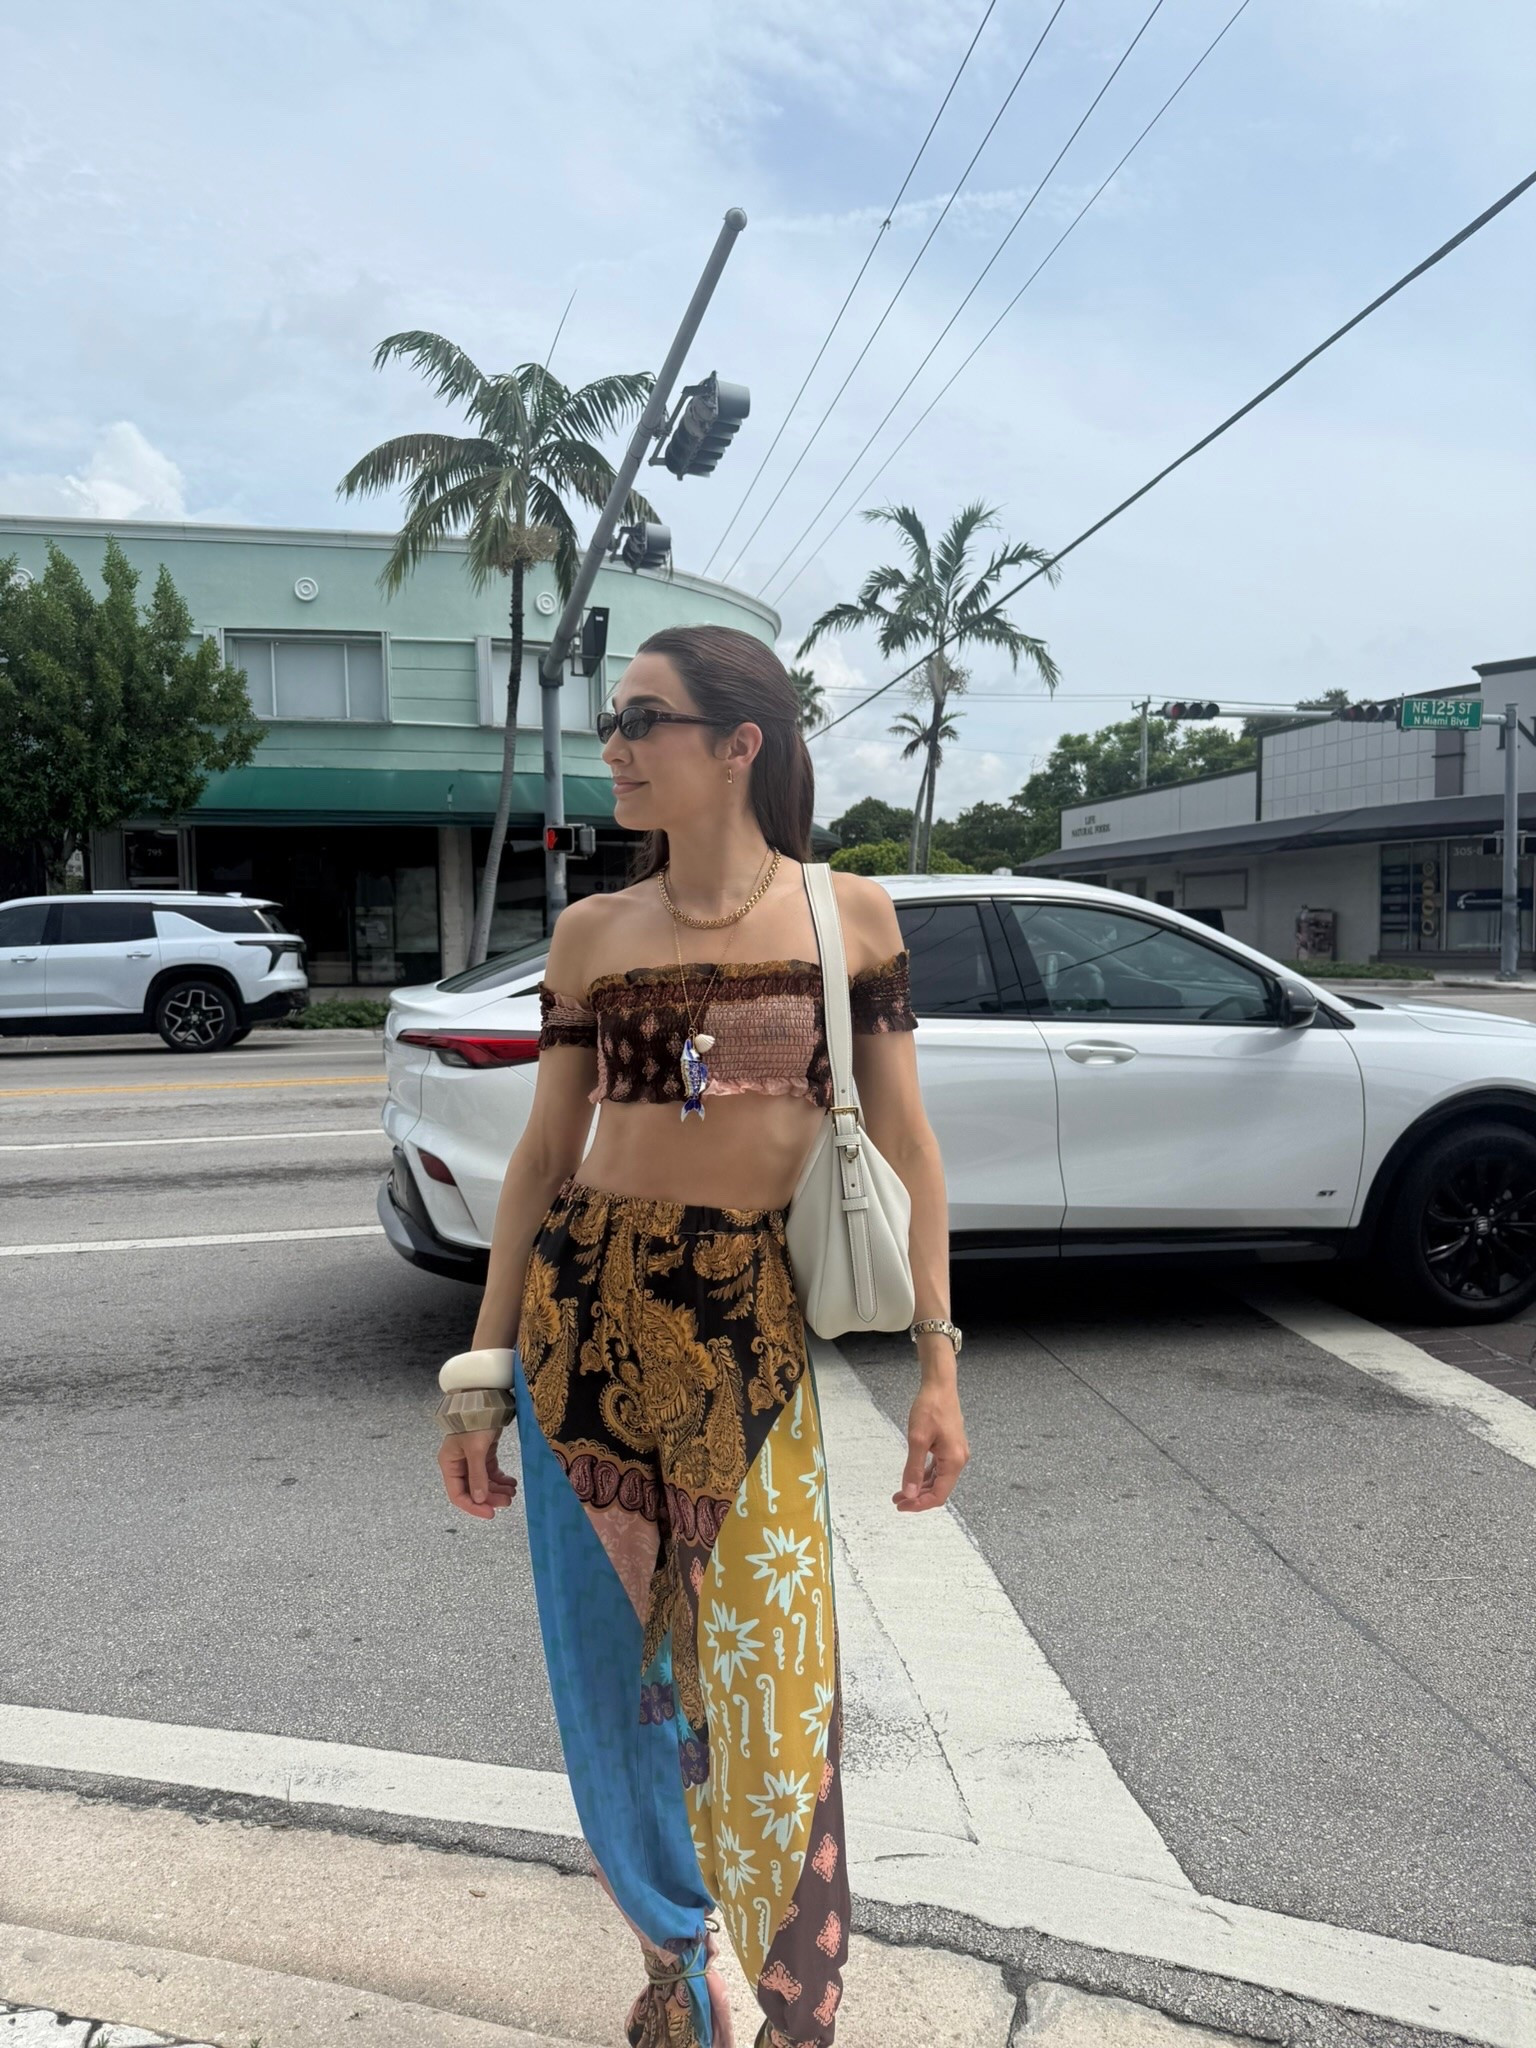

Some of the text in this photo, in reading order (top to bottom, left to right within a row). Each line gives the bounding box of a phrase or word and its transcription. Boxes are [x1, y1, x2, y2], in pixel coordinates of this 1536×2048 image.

[1412, 701, 1472, 716] NE 125 ST
[1413, 716, 1469, 726] N Miami Blvd
